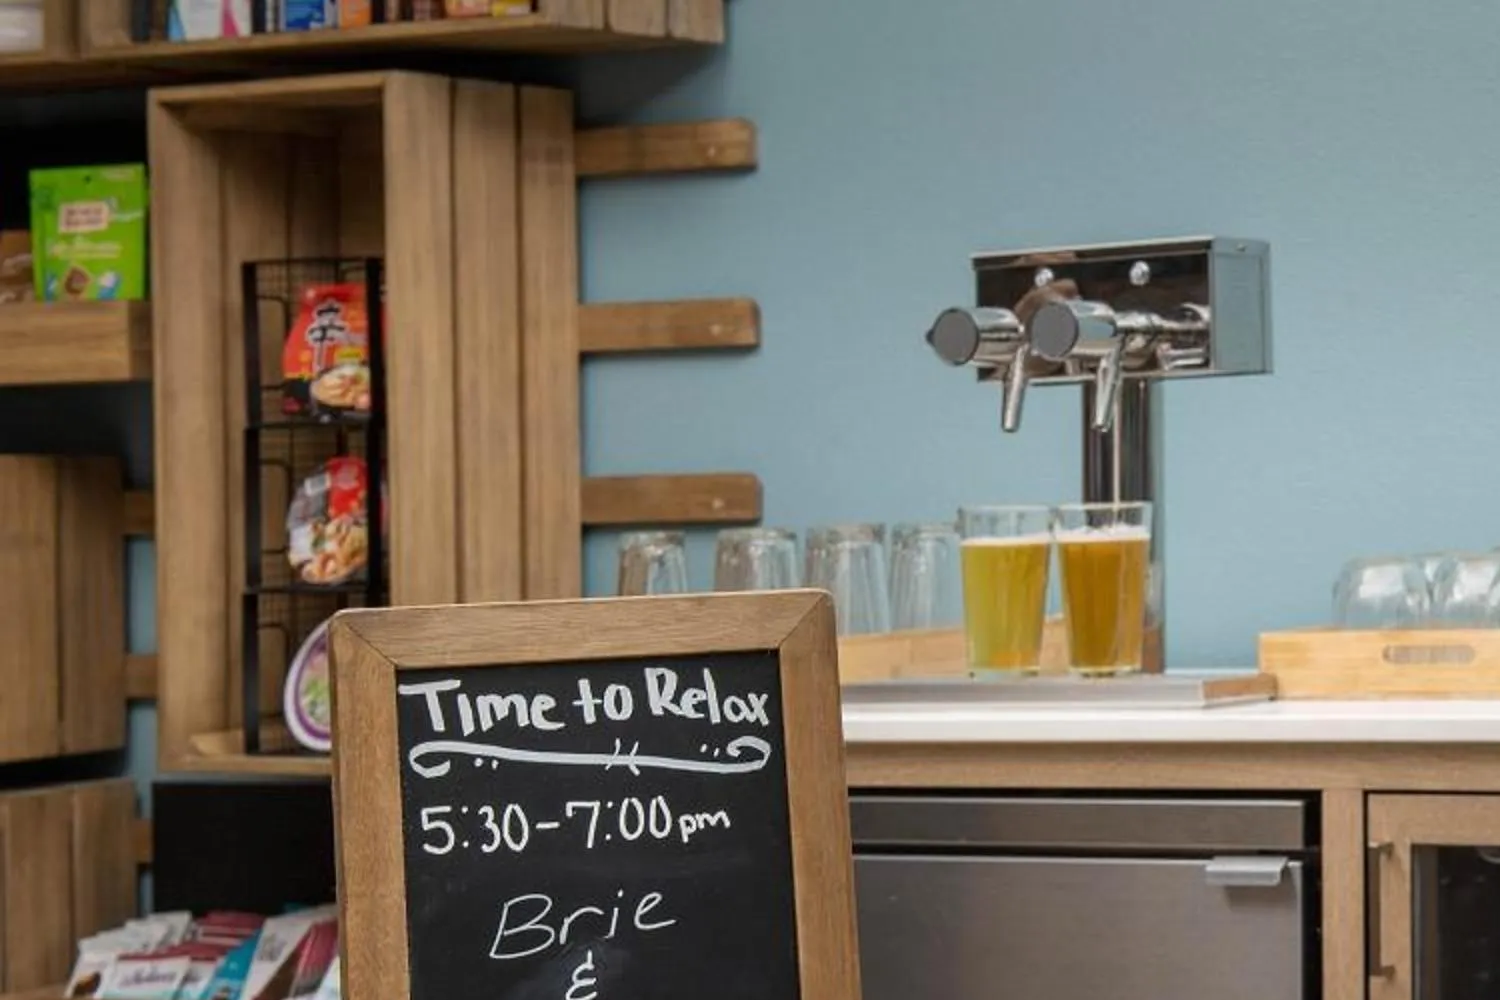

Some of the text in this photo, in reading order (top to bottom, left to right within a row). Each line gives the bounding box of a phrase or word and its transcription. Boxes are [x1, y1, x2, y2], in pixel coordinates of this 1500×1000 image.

[397, 667, 770, 737] Time to Relax
[677, 809, 731, 844] pm
[488, 889, 677, 963] Brie
